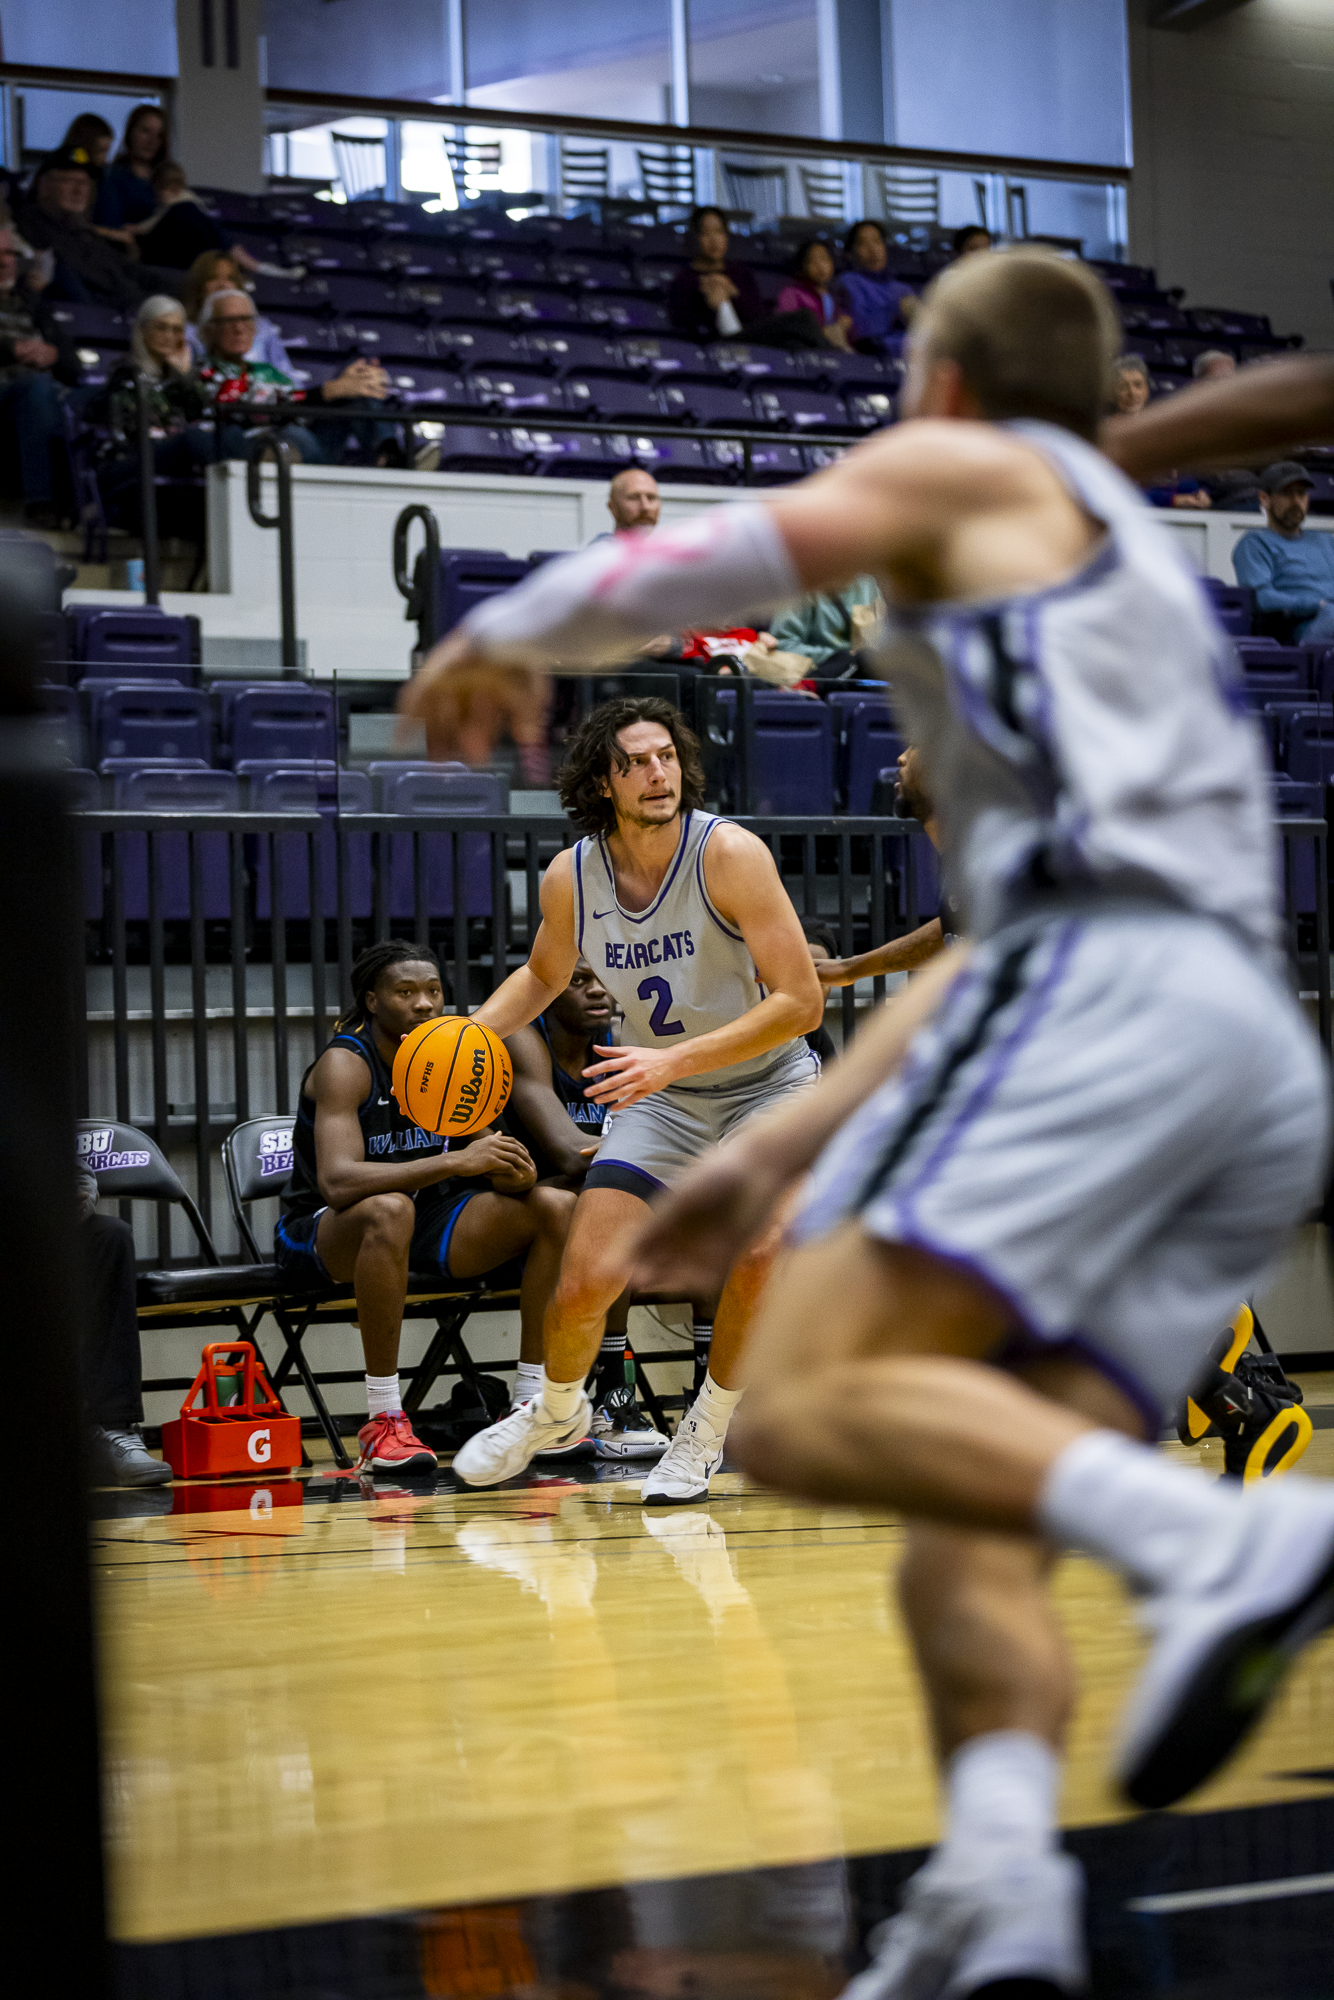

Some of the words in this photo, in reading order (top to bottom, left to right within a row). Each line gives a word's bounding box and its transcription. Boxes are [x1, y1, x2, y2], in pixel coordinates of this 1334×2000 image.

[604, 930, 695, 970] BEARCATS
[637, 975, 686, 1037] 2
[421, 1061, 434, 1087] NFHS
[448, 1048, 486, 1124] Wilson
[77, 1130, 113, 1155] BU
[262, 1130, 293, 1153] SB
[82, 1152, 149, 1170] ARCATS
[247, 1429, 271, 1463] G
